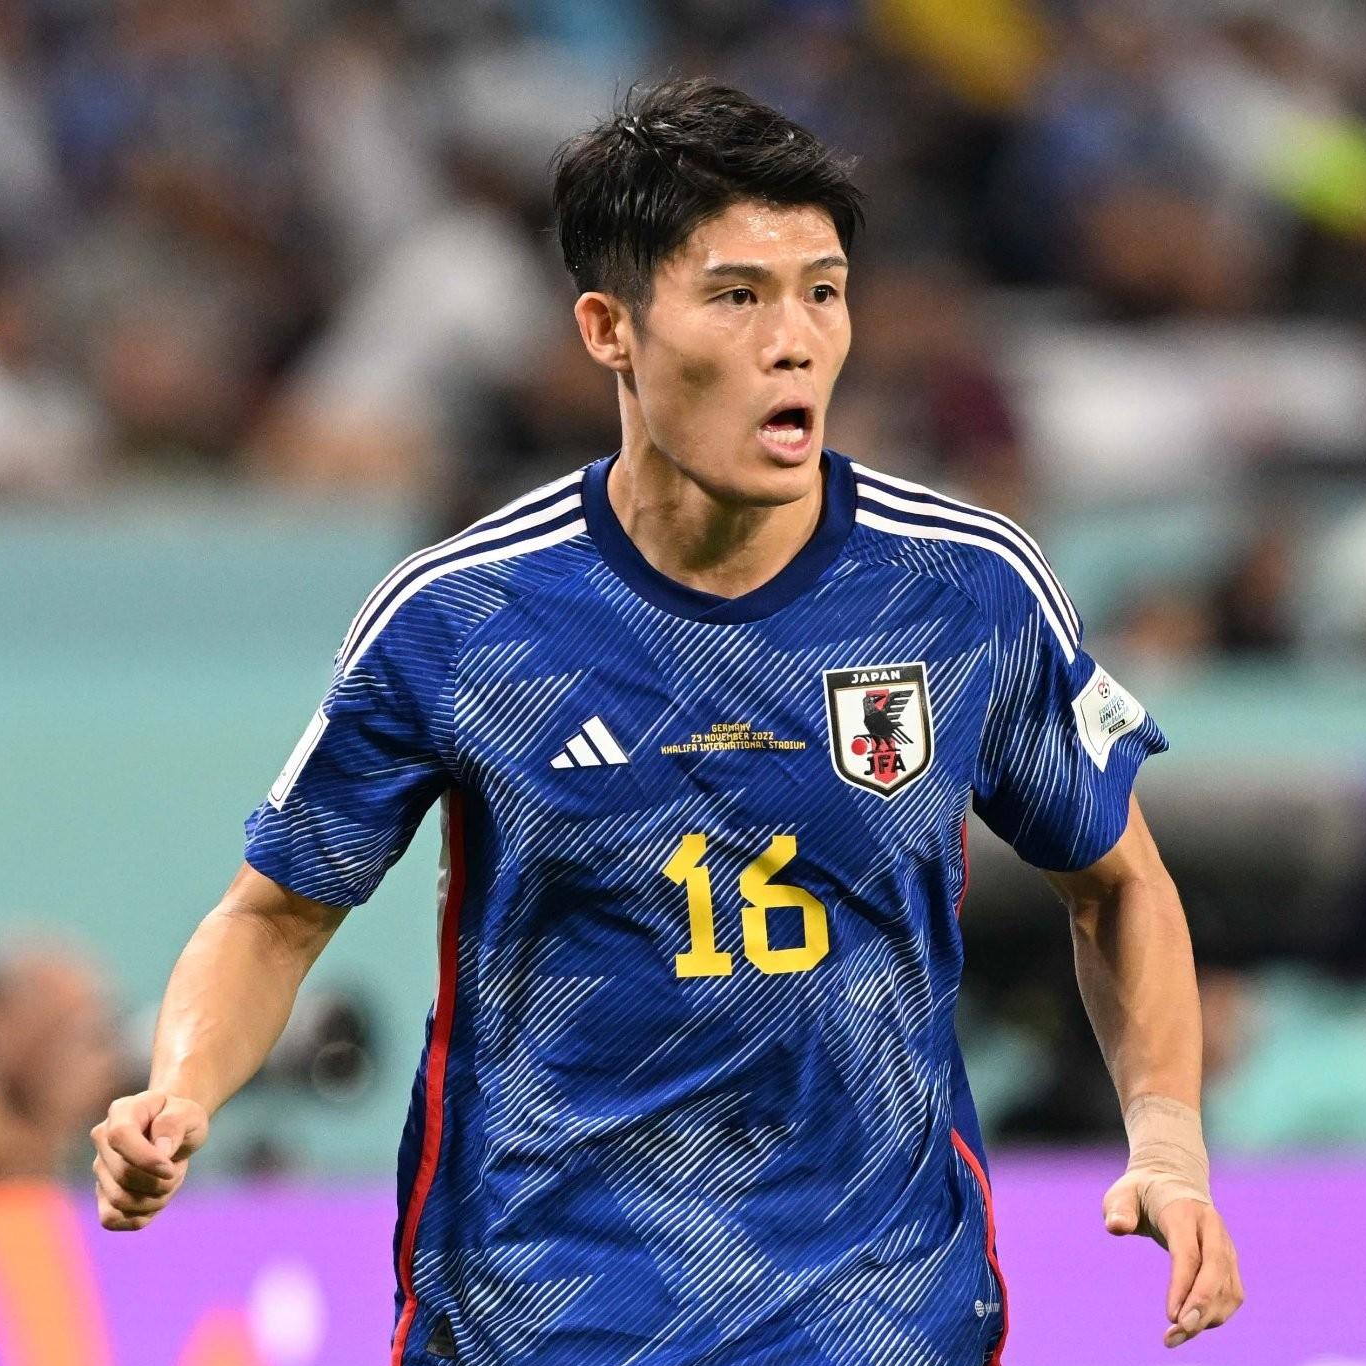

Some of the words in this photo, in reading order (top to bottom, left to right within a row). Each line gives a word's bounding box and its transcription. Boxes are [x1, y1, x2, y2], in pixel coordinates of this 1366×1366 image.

[851, 670, 901, 684] JAPAN
[711, 723, 752, 733] GERMANY
[691, 734, 702, 743] 23
[704, 732, 750, 743] NOVEMBER
[752, 732, 775, 740] 2022
[661, 743, 698, 755] KHALIFA
[700, 741, 766, 752] INTERNATIONAL
[769, 740, 806, 750] STADIUM
[864, 753, 906, 776] JFA
[662, 833, 829, 977] 16
